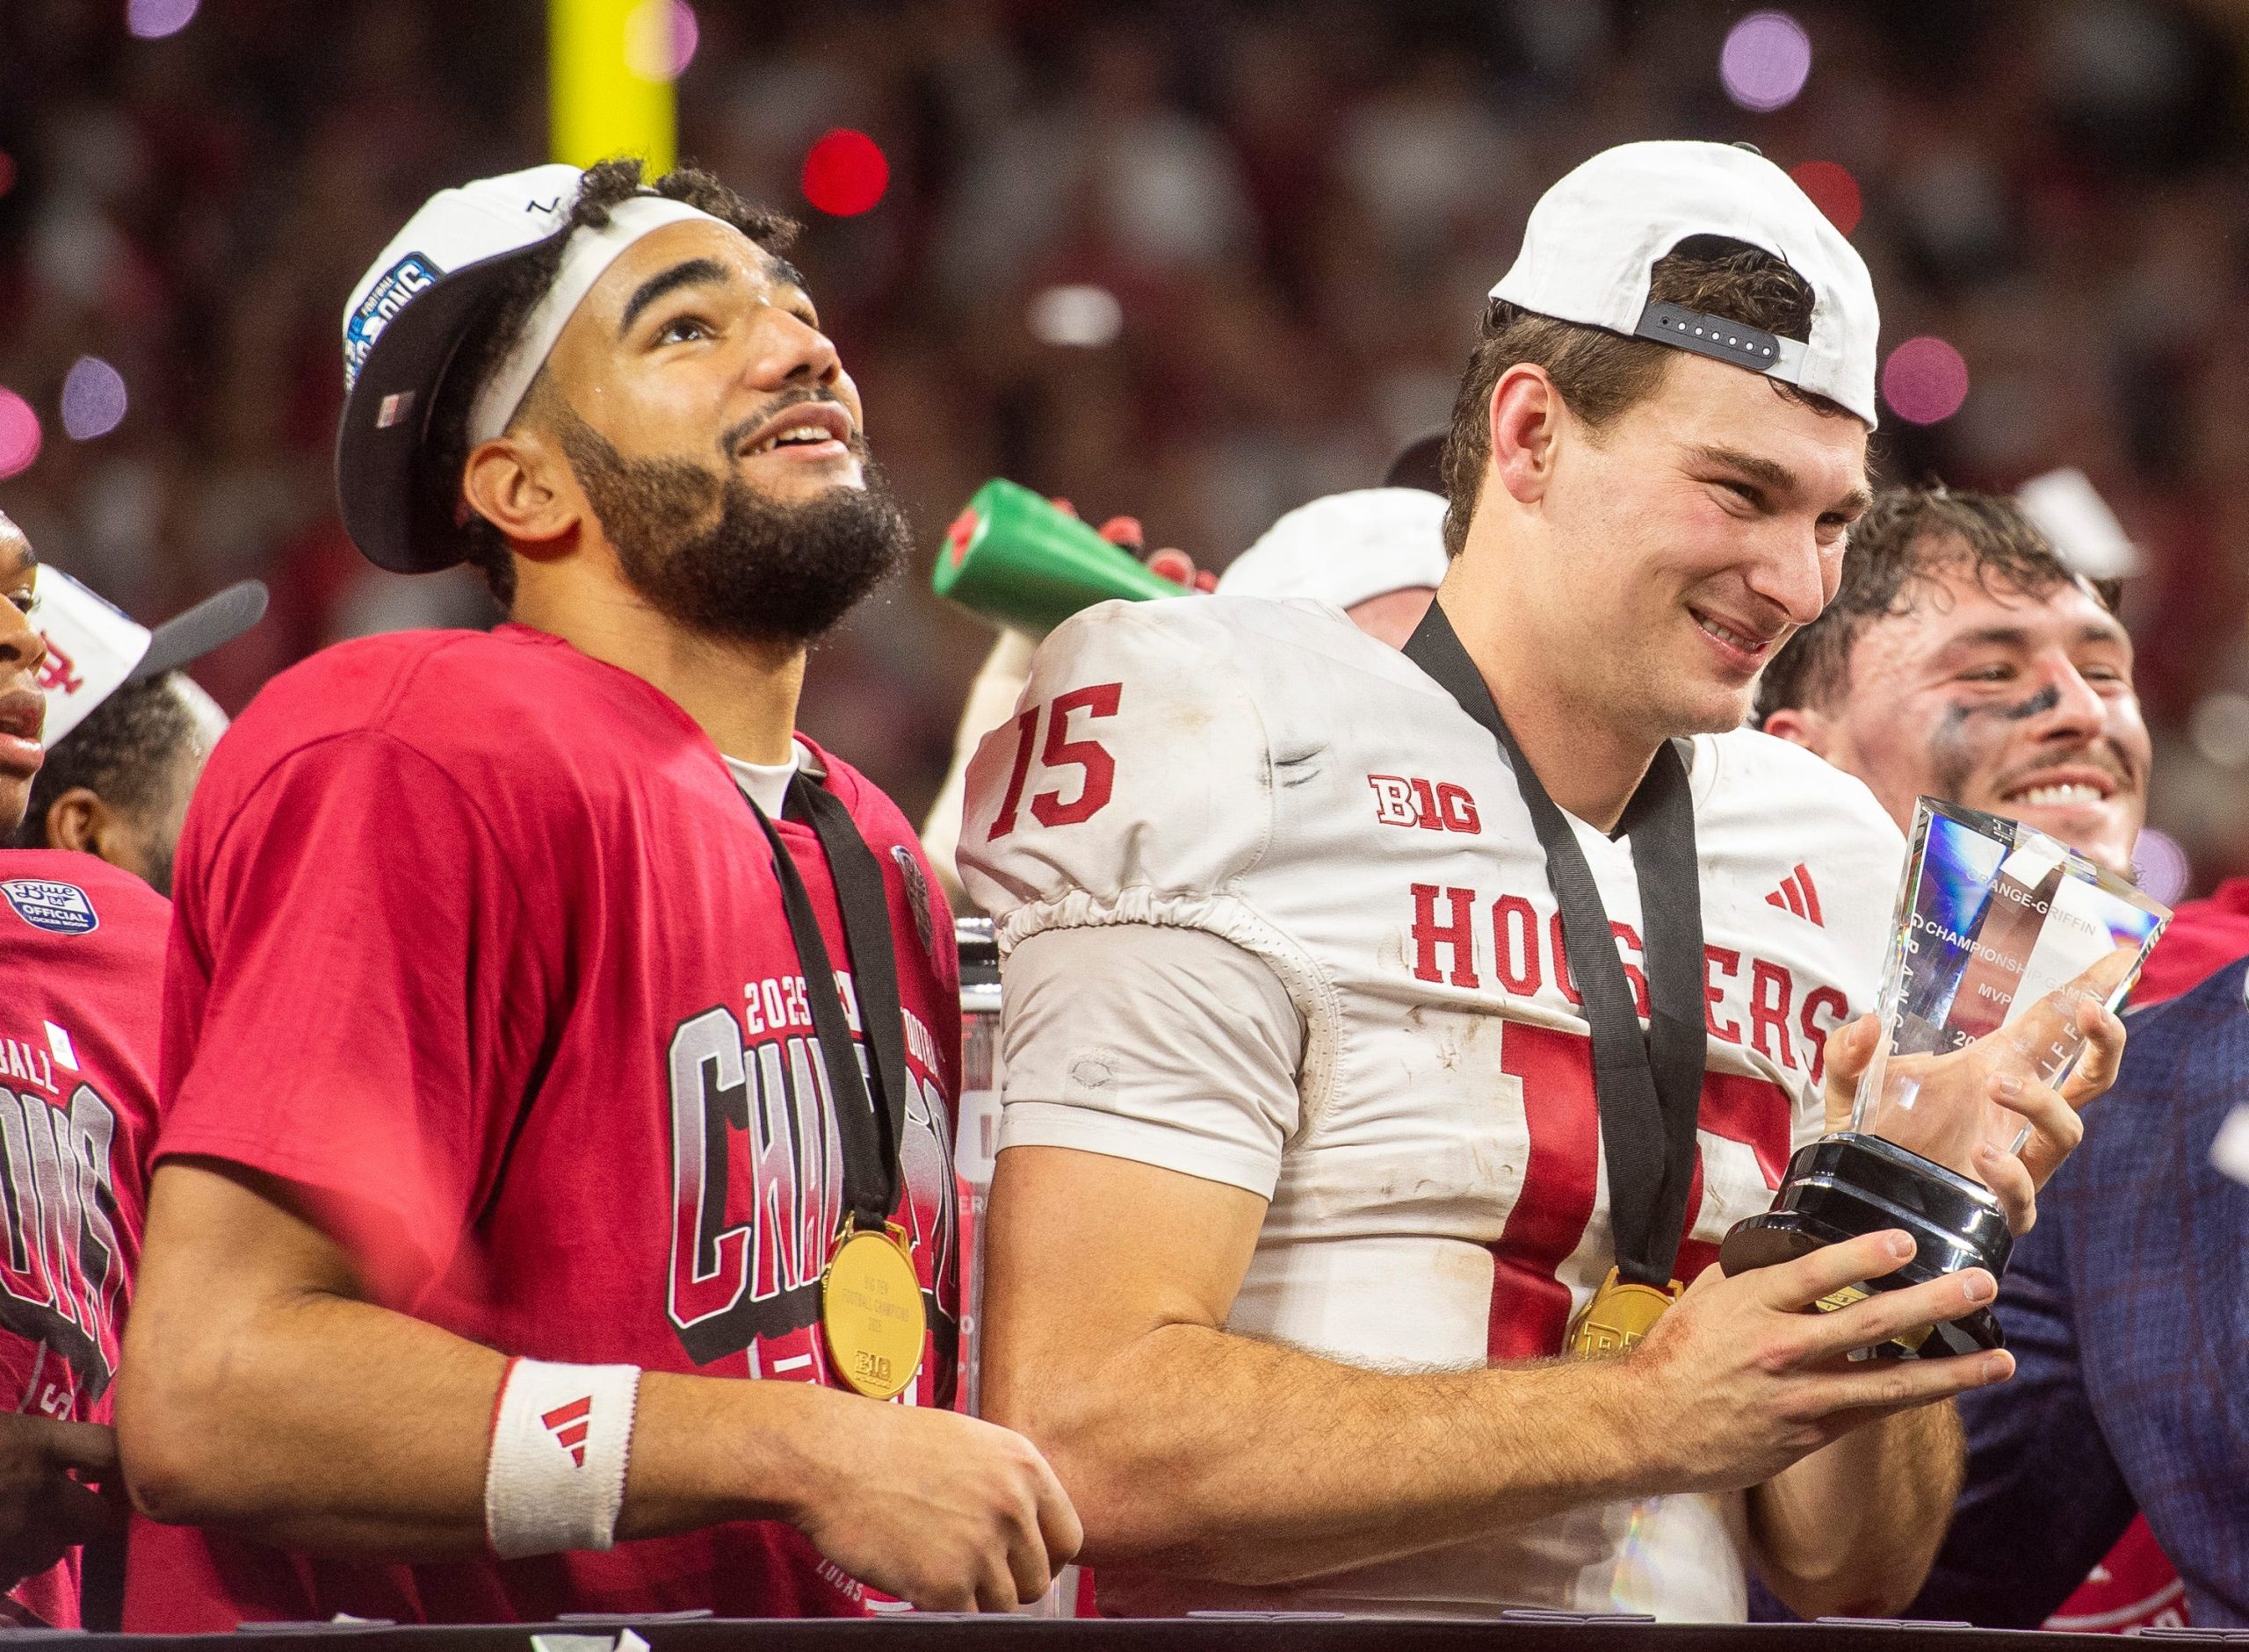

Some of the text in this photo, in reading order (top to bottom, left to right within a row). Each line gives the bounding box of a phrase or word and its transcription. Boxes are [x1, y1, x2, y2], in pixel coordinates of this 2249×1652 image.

[360, 276, 395, 317] FOOTBALL
[987, 682, 1123, 842] 15
[13, 884, 76, 900] Blue
[22, 905, 90, 923] OFFICIAL
[1925, 920, 2043, 981] CHAMPIONSHIP
[744, 975, 813, 1035] 2025
[1410, 884, 1850, 1086] HOSERS
[1977, 982, 2013, 1006] MVP
[815, 1558, 864, 1602] LUCAS
